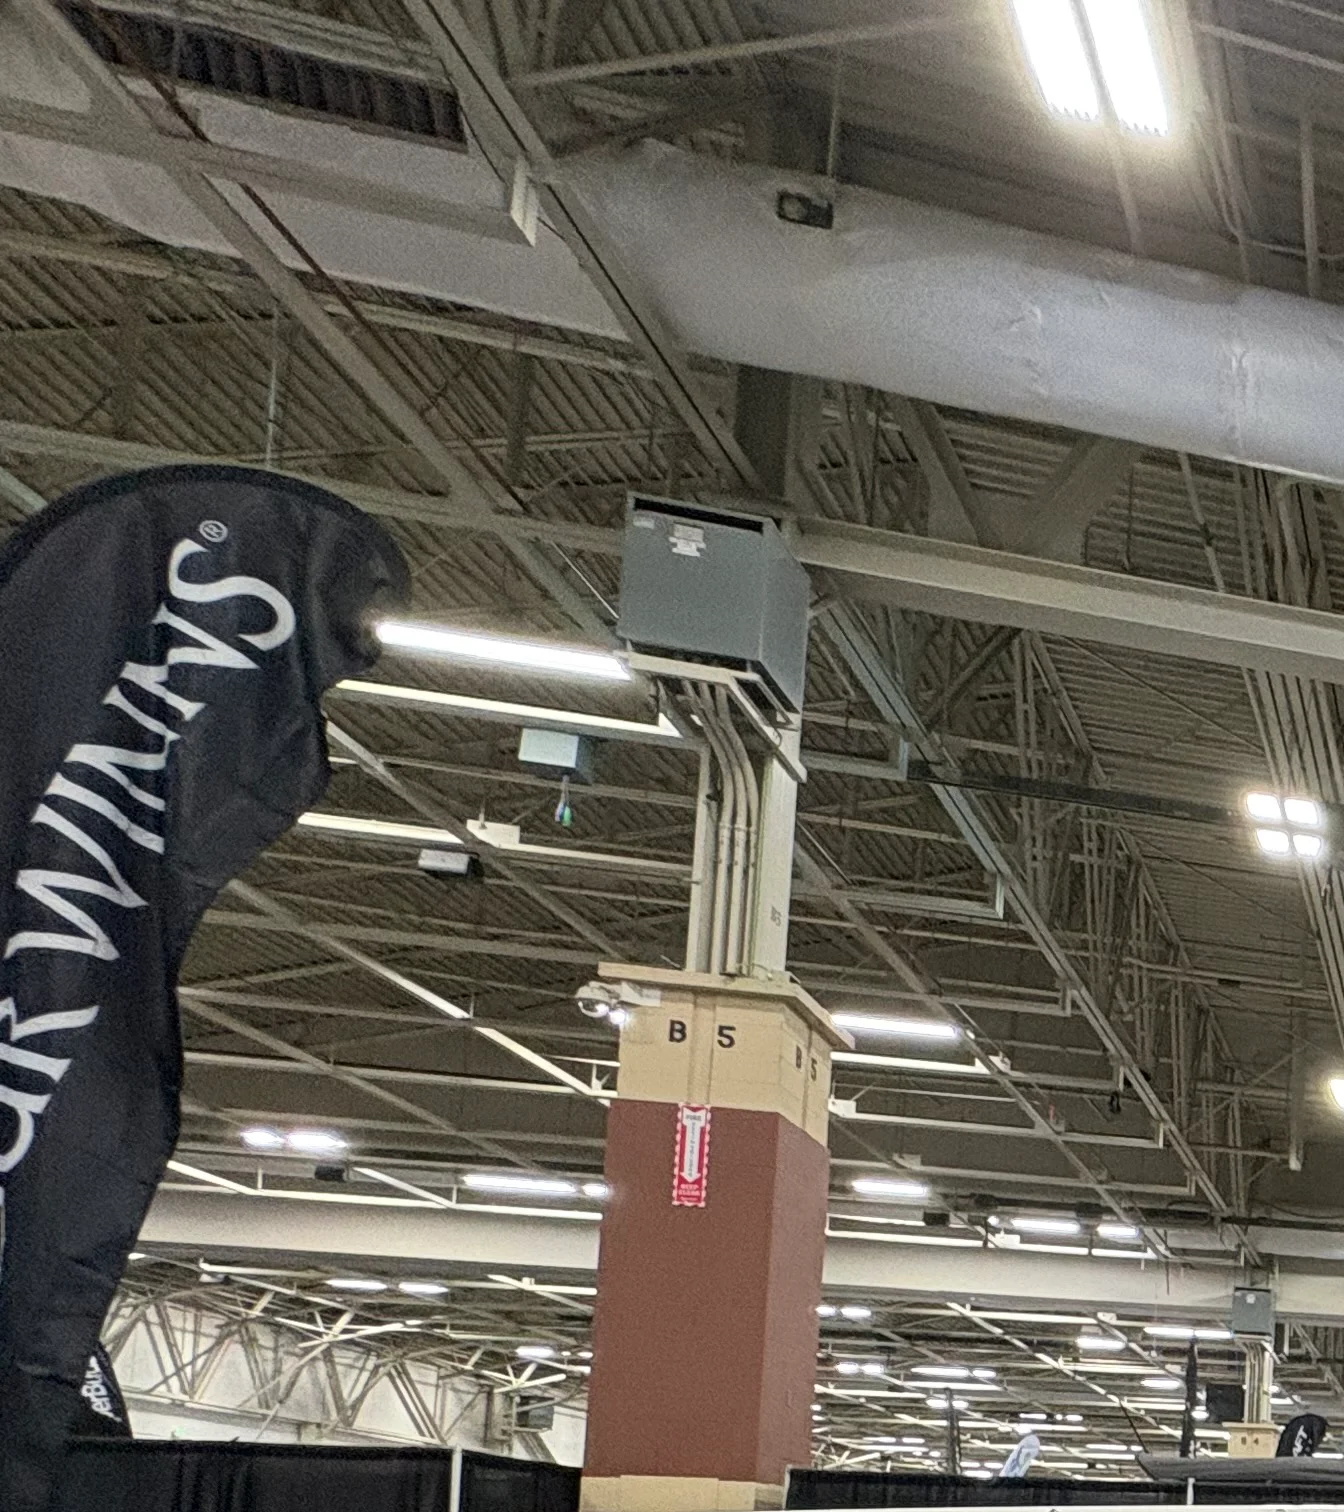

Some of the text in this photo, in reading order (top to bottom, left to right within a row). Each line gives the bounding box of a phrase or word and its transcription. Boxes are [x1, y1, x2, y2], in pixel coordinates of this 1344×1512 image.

[667, 1018, 736, 1049] B 5
[810, 1057, 818, 1082] 5
